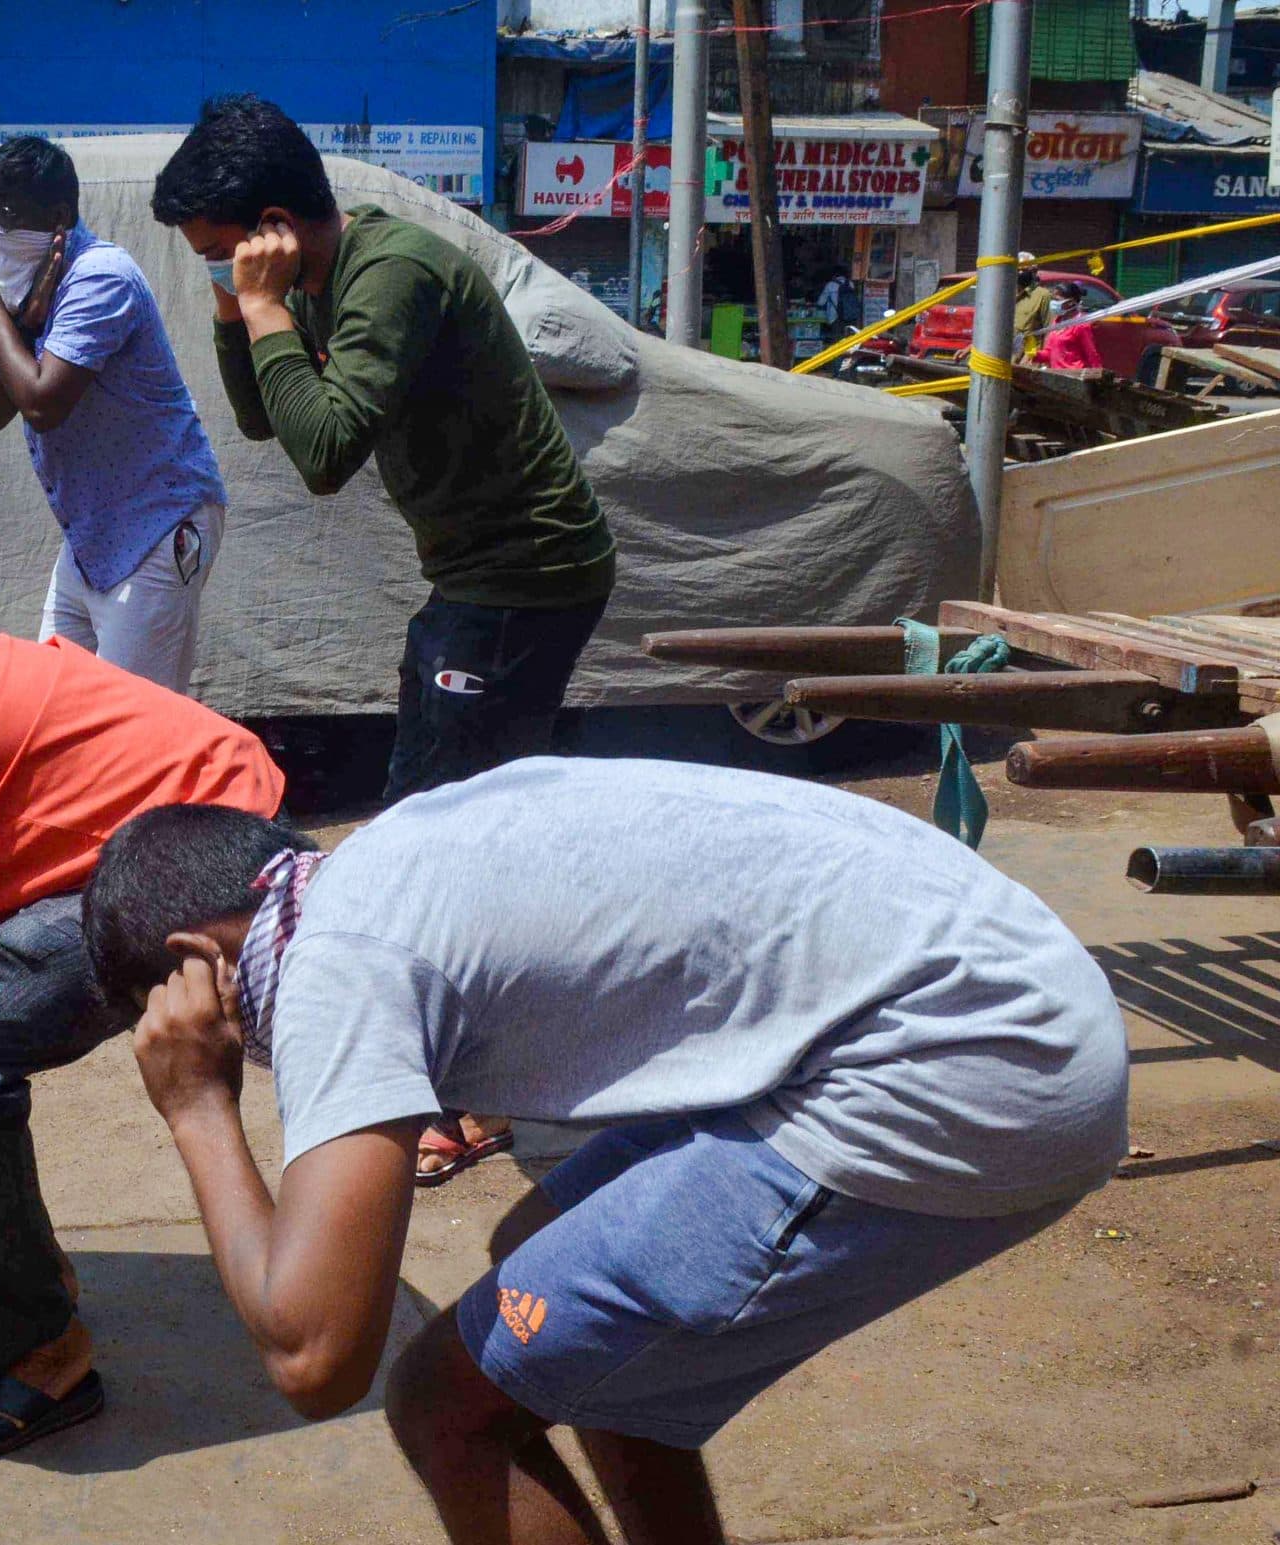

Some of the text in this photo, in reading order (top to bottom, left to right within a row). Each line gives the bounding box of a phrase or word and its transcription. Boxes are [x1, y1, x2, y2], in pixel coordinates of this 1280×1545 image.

[377, 131, 402, 145] SHOP
[408, 132, 414, 145] &
[420, 132, 477, 146] REPAIRING
[802, 141, 906, 167] MEDICAL
[776, 168, 846, 193] ENERAL
[849, 169, 920, 194] STORES
[533, 190, 603, 205] HAVELLS
[796, 194, 808, 208] &
[811, 194, 894, 209] DRUGGIST
